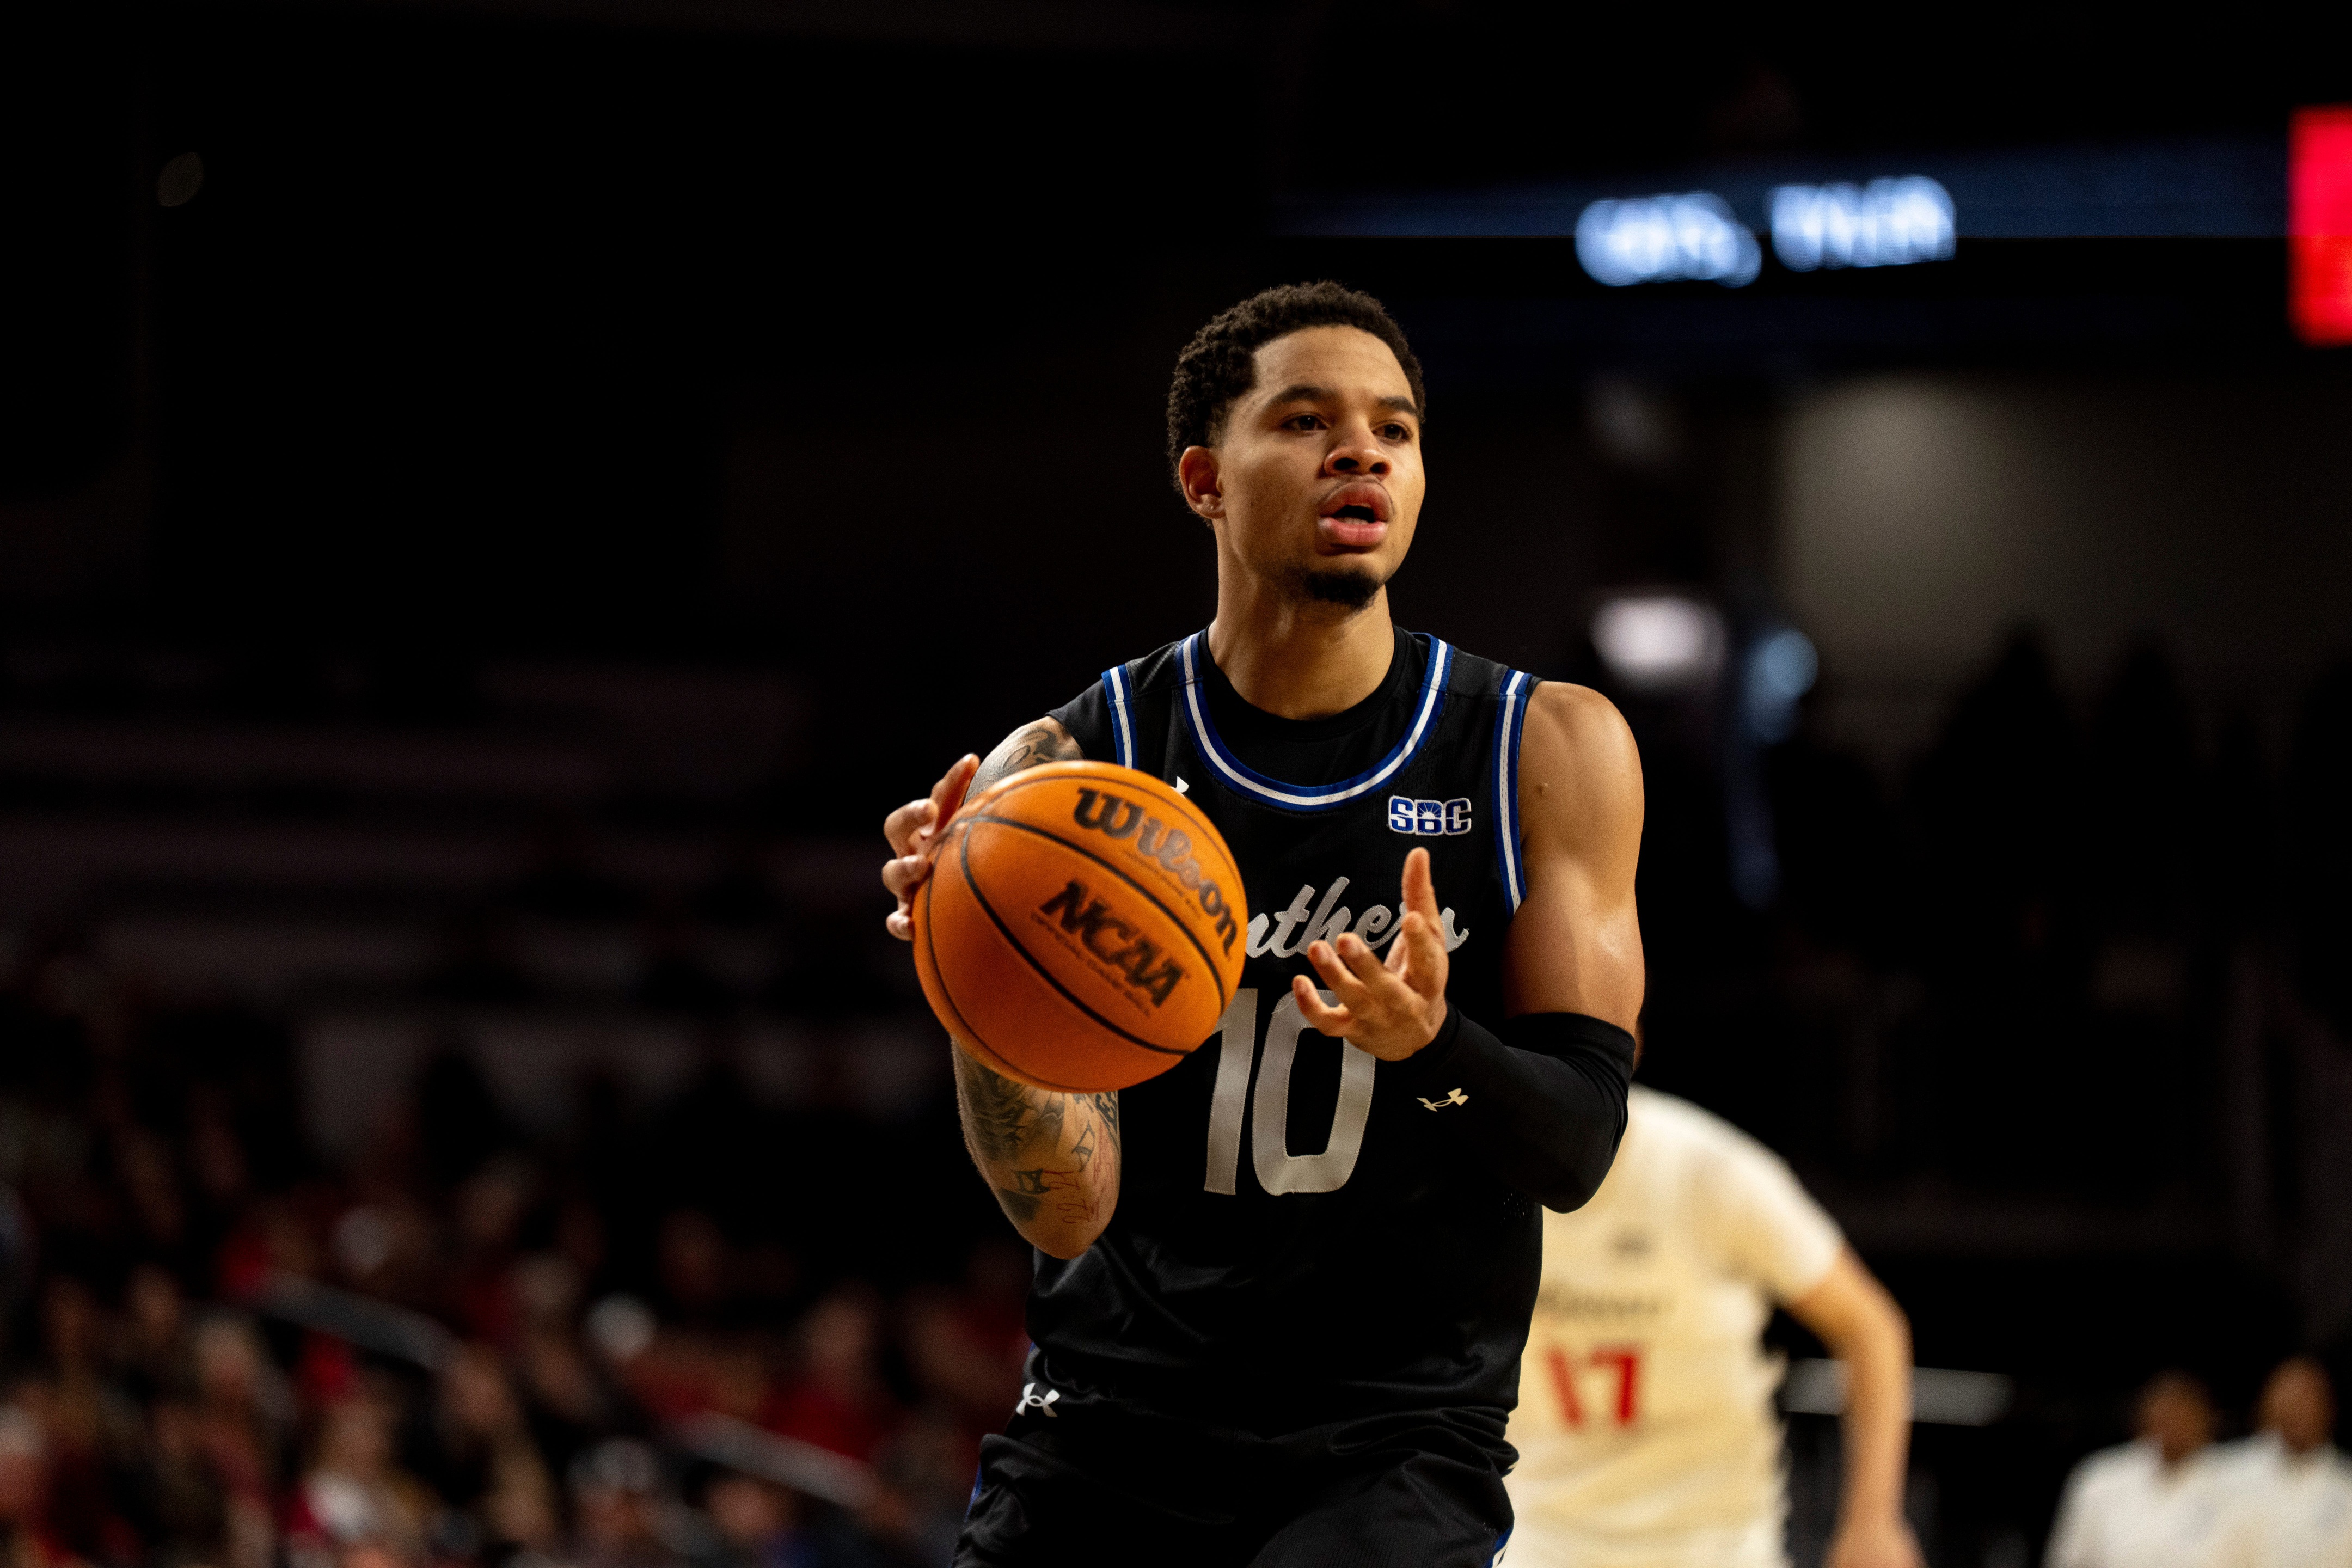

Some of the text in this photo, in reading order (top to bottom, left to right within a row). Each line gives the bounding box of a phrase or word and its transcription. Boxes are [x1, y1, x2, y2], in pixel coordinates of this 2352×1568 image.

[1073, 787, 1238, 961] Wilson
[1388, 795, 1472, 836] SBC
[1039, 879, 1186, 1008] NCAA
[1204, 977, 1376, 1197] 10
